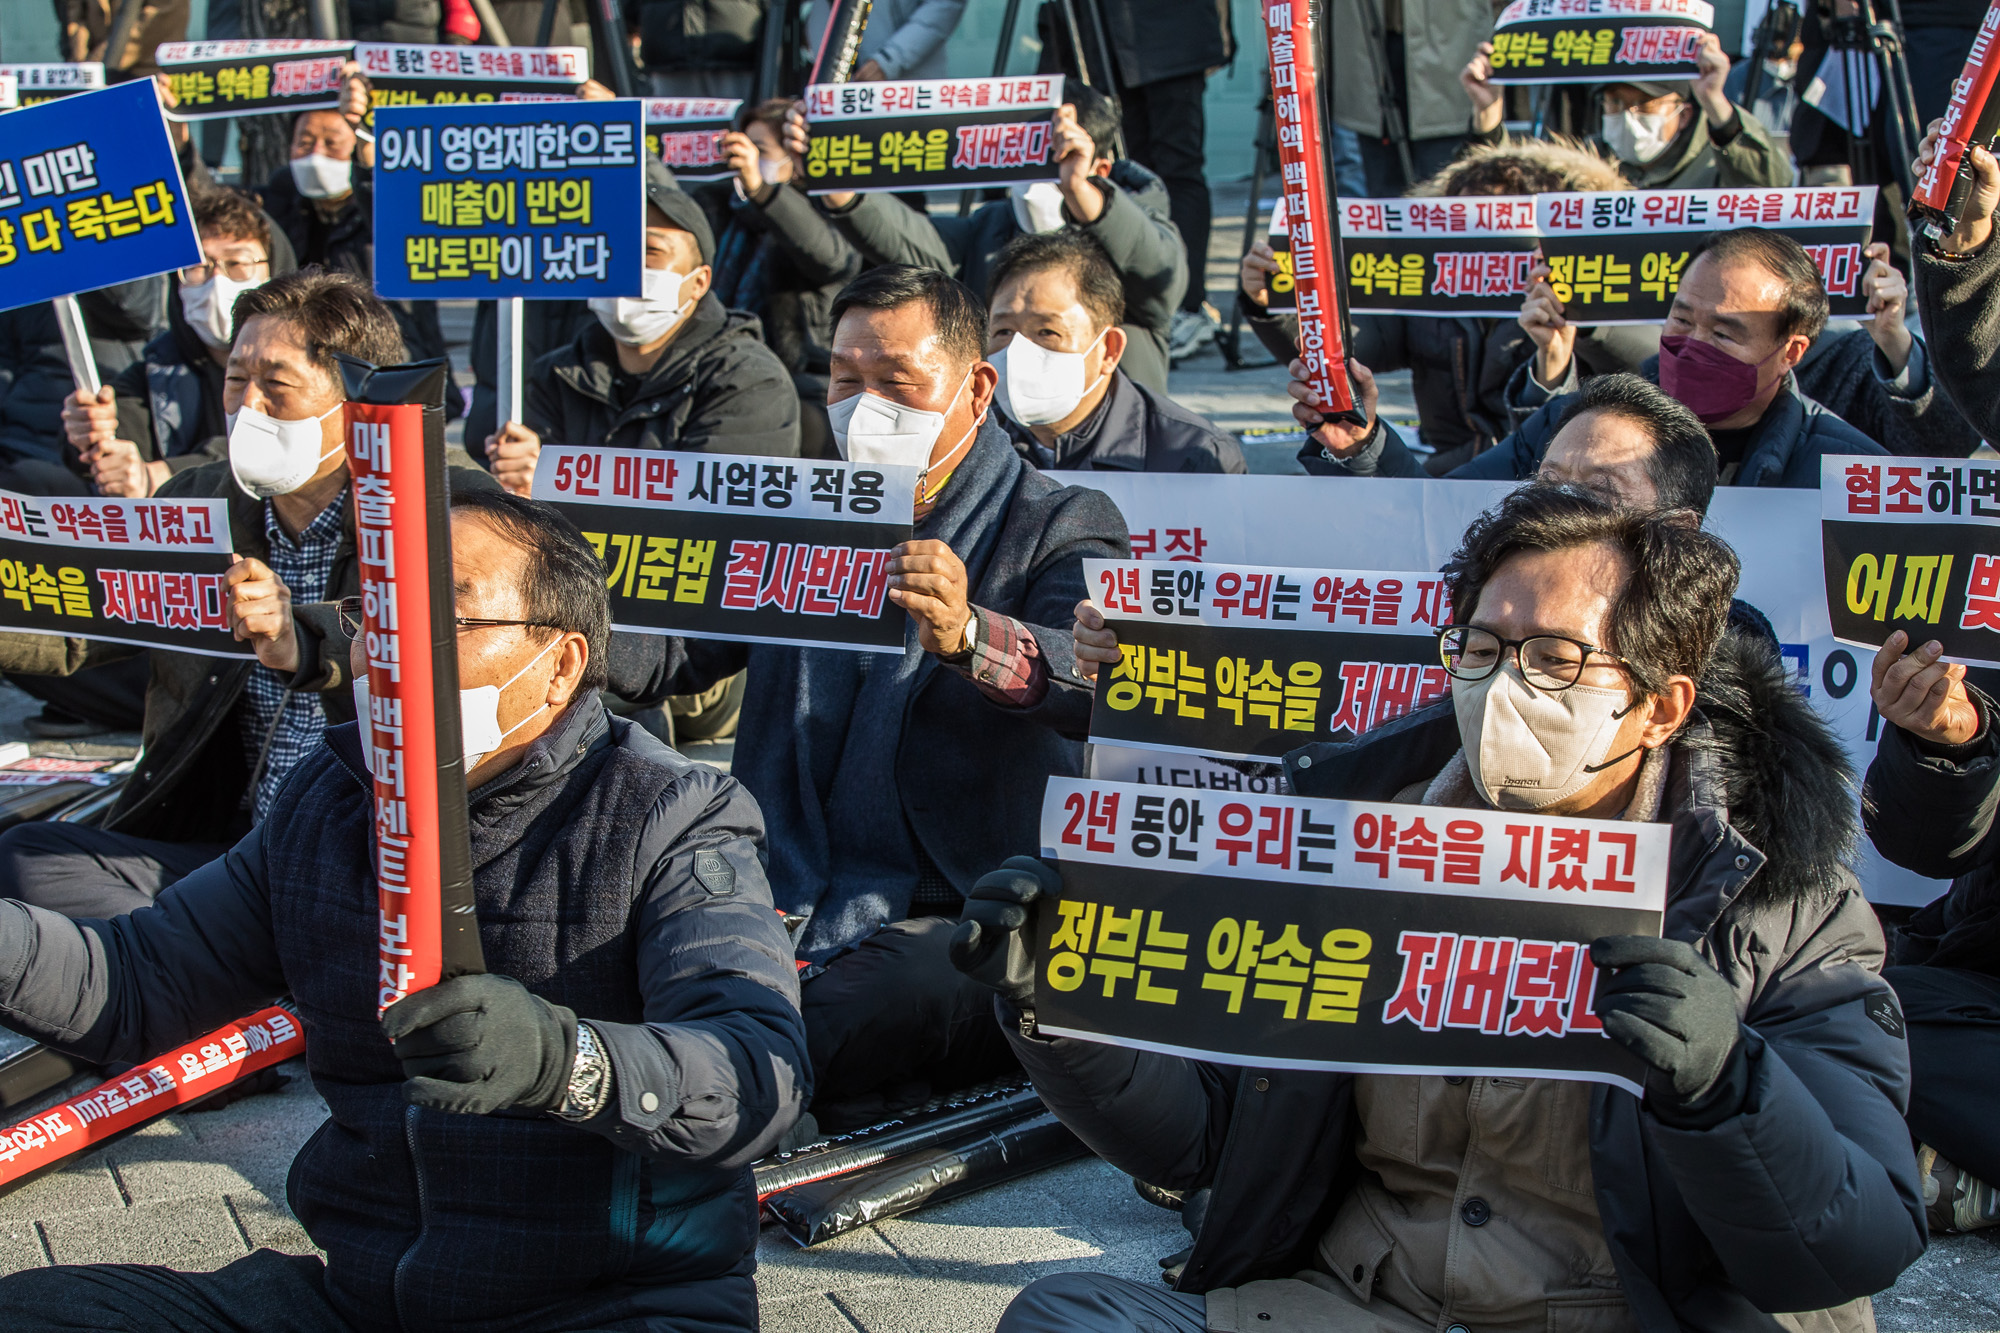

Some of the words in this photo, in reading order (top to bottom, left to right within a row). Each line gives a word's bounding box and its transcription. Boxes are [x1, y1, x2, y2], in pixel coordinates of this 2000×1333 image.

[365, 50, 390, 73] 2년
[395, 50, 425, 74] 동안
[429, 51, 475, 75] 우리는
[478, 52, 526, 77] 약속을
[529, 53, 577, 78] 지켰고
[1268, 2, 1304, 153] 매출피해액
[1489, 31, 1549, 69] 정부는
[1551, 28, 1616, 67] 약속을
[216, 64, 271, 102] 약속을
[841, 87, 874, 113] 동안
[881, 86, 933, 112] 우리는
[939, 83, 992, 109] 약속을
[997, 79, 1052, 105] 지켰고
[22, 143, 99, 196] 미만
[381, 127, 432, 172] 9시
[440, 123, 636, 173] 영업제한으로
[807, 134, 874, 178] 정부는
[879, 128, 950, 174] 약속을
[952, 121, 1054, 170] 저버렸다
[21, 208, 63, 252] 다
[66, 180, 176, 241] 죽는다
[421, 180, 516, 226] 매출이
[525, 179, 592, 226] 반의
[1283, 160, 1319, 280] 백퍼센트
[1347, 203, 1403, 232] 우리는
[1409, 203, 1467, 232] 약속을
[1474, 201, 1534, 232] 지켰고
[1548, 198, 1584, 230] 2년
[1592, 196, 1636, 228] 동안
[1641, 195, 1709, 226] 우리는
[1716, 193, 1784, 224] 약속을
[1790, 190, 1860, 222] 지켰고
[406, 236, 532, 281] 반토막이
[542, 235, 611, 281] 났다
[1350, 252, 1426, 296] 약속을
[1430, 251, 1536, 298] 저버렸다
[1548, 252, 1632, 305] 정부는
[1298, 289, 1335, 407] 보장하라
[554, 453, 602, 497] 5인
[613, 456, 679, 502] 미만
[688, 460, 799, 510] 사업장
[810, 466, 886, 515] 적용
[50, 503, 130, 544] 약속을
[134, 504, 215, 545] 지켰고
[353, 421, 402, 684] 매출피해액
[0, 558, 94, 619] 약속을
[96, 568, 232, 632] 저버렸다
[720, 540, 893, 620] 결사반대
[1099, 567, 1144, 615] 2년
[1150, 568, 1206, 617] 동안
[1212, 571, 1302, 622] 우리는
[1311, 576, 1404, 626] 약속을
[1106, 644, 1208, 721] 정부는
[1214, 656, 1324, 733] 약속을
[369, 693, 411, 895] 백퍼센트
[1061, 790, 1121, 854] 2년
[1131, 794, 1205, 862] 동안
[1215, 802, 1337, 874] 우리는
[1353, 812, 1485, 886] 약속을
[1499, 823, 1638, 894] 지켰고
[377, 908, 416, 1010] 보장
[1046, 900, 1190, 1006] 정부는
[1201, 916, 1373, 1025] 약속을
[177, 1014, 297, 1084] 매출피해액
[66, 1064, 177, 1129] 백퍼센트
